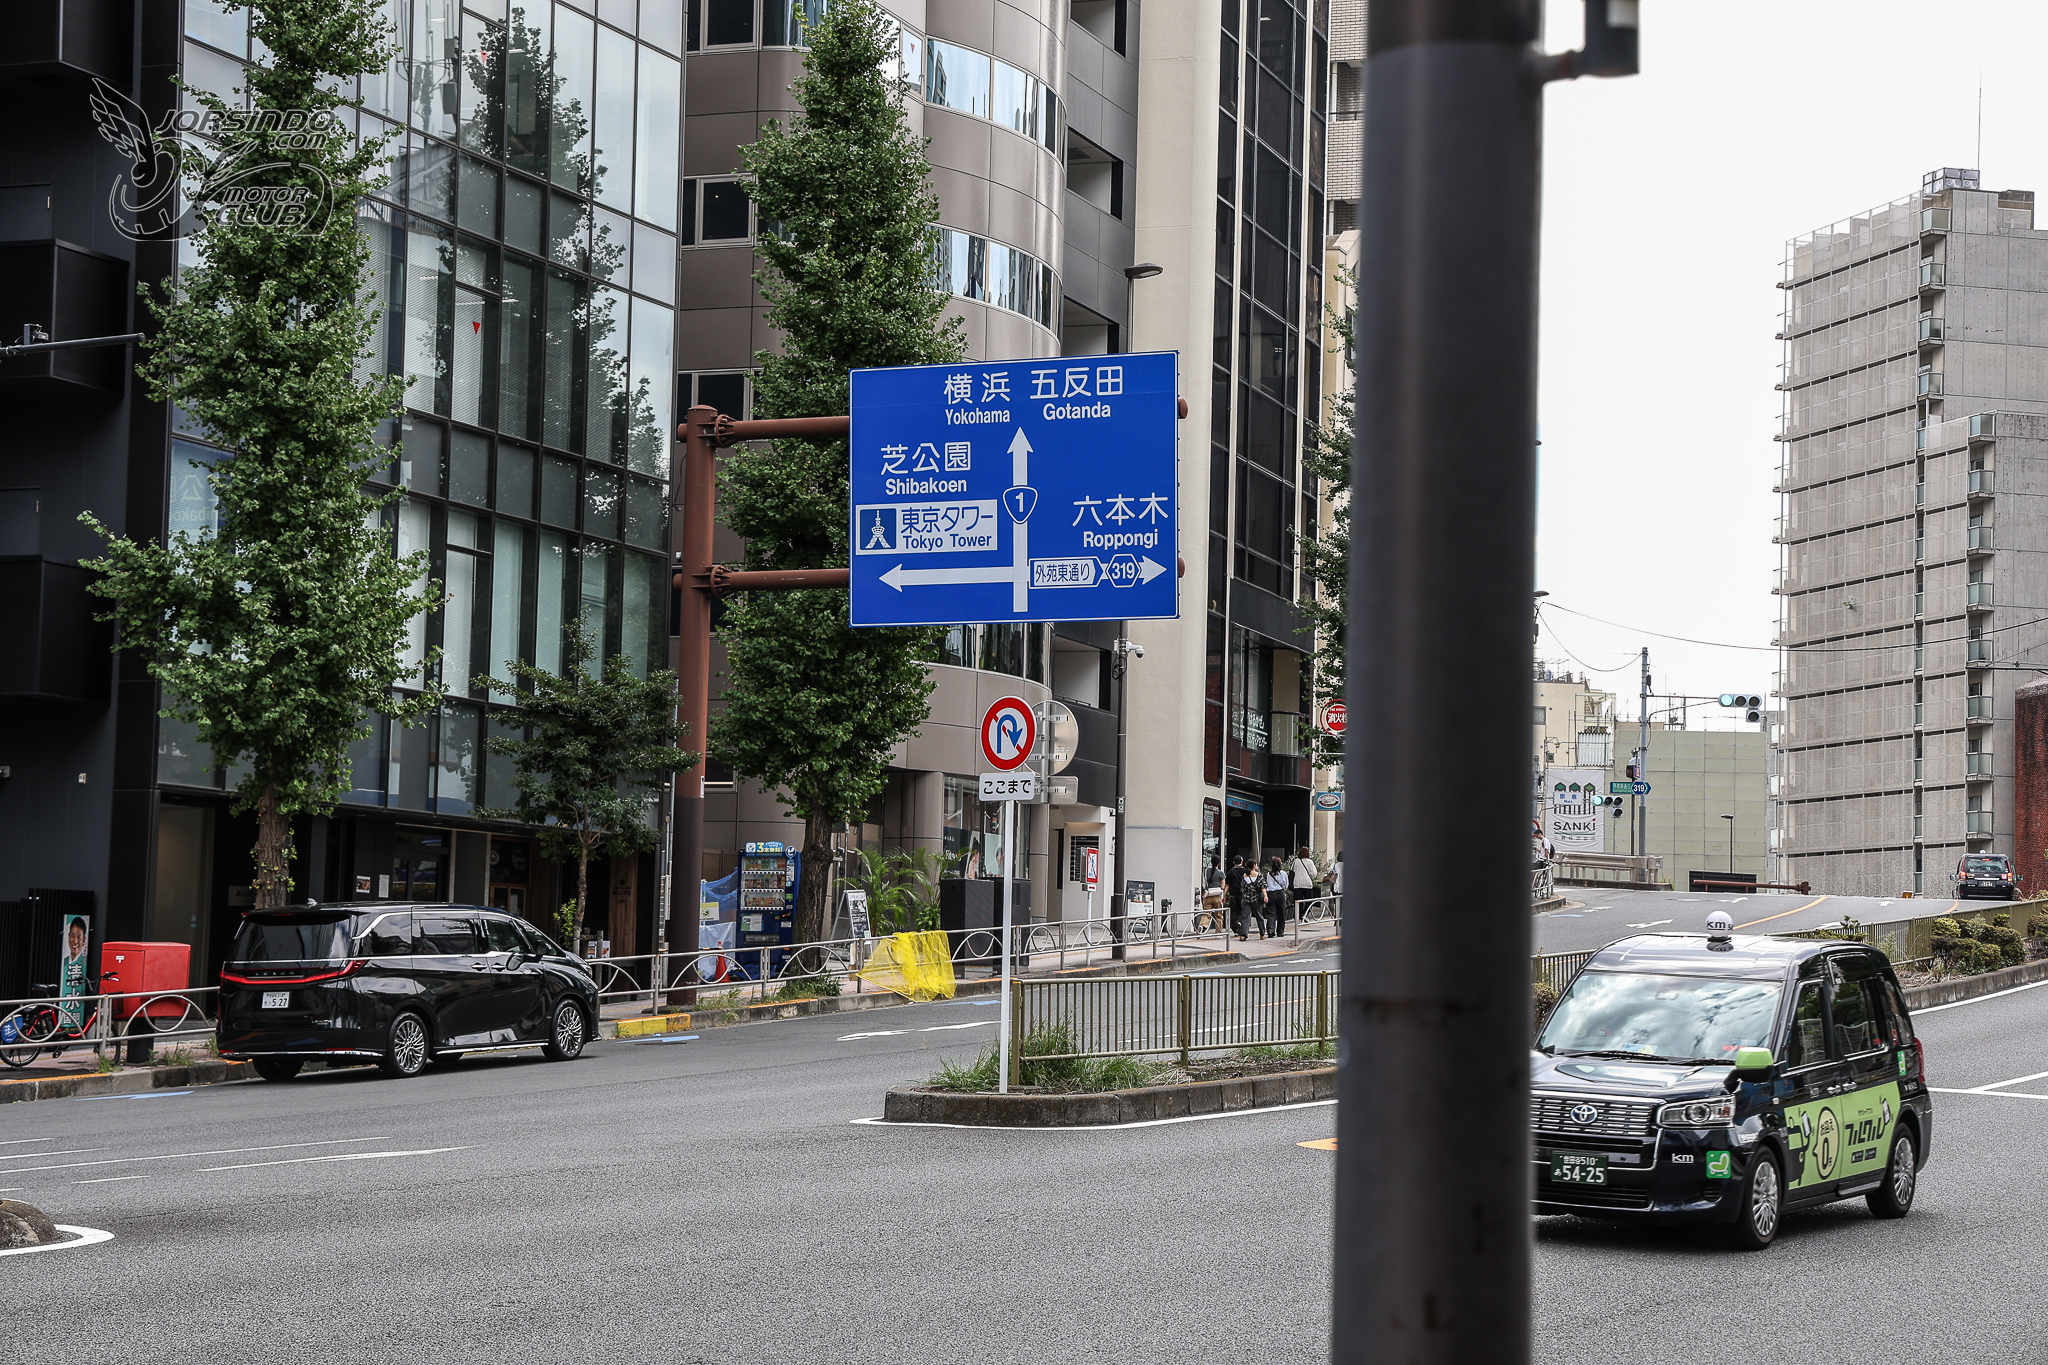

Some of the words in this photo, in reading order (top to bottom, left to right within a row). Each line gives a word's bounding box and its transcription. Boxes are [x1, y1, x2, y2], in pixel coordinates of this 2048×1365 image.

[944, 372, 1011, 404] 横浜
[1030, 366, 1124, 399] 五反田
[945, 409, 1010, 425] Yokohama
[1043, 402, 1111, 421] Gotanda
[881, 442, 971, 475] 芝公園
[885, 478, 967, 496] Shibakoen
[1015, 492, 1024, 512] 1
[1073, 493, 1168, 527] 六本木
[901, 506, 994, 534] 東京タワー
[902, 535, 943, 552] Tokyo
[950, 534, 992, 548] Tower
[1083, 529, 1159, 550] Roppongi
[1035, 563, 1091, 583] 外苑東通り
[1112, 562, 1134, 580] 319
[983, 779, 1031, 795] ここまで
[1634, 784, 1645, 792] 319
[1707, 920, 1726, 928] km
[1671, 1153, 1694, 1162] km
[1562, 1165, 1605, 1183] 54-25
